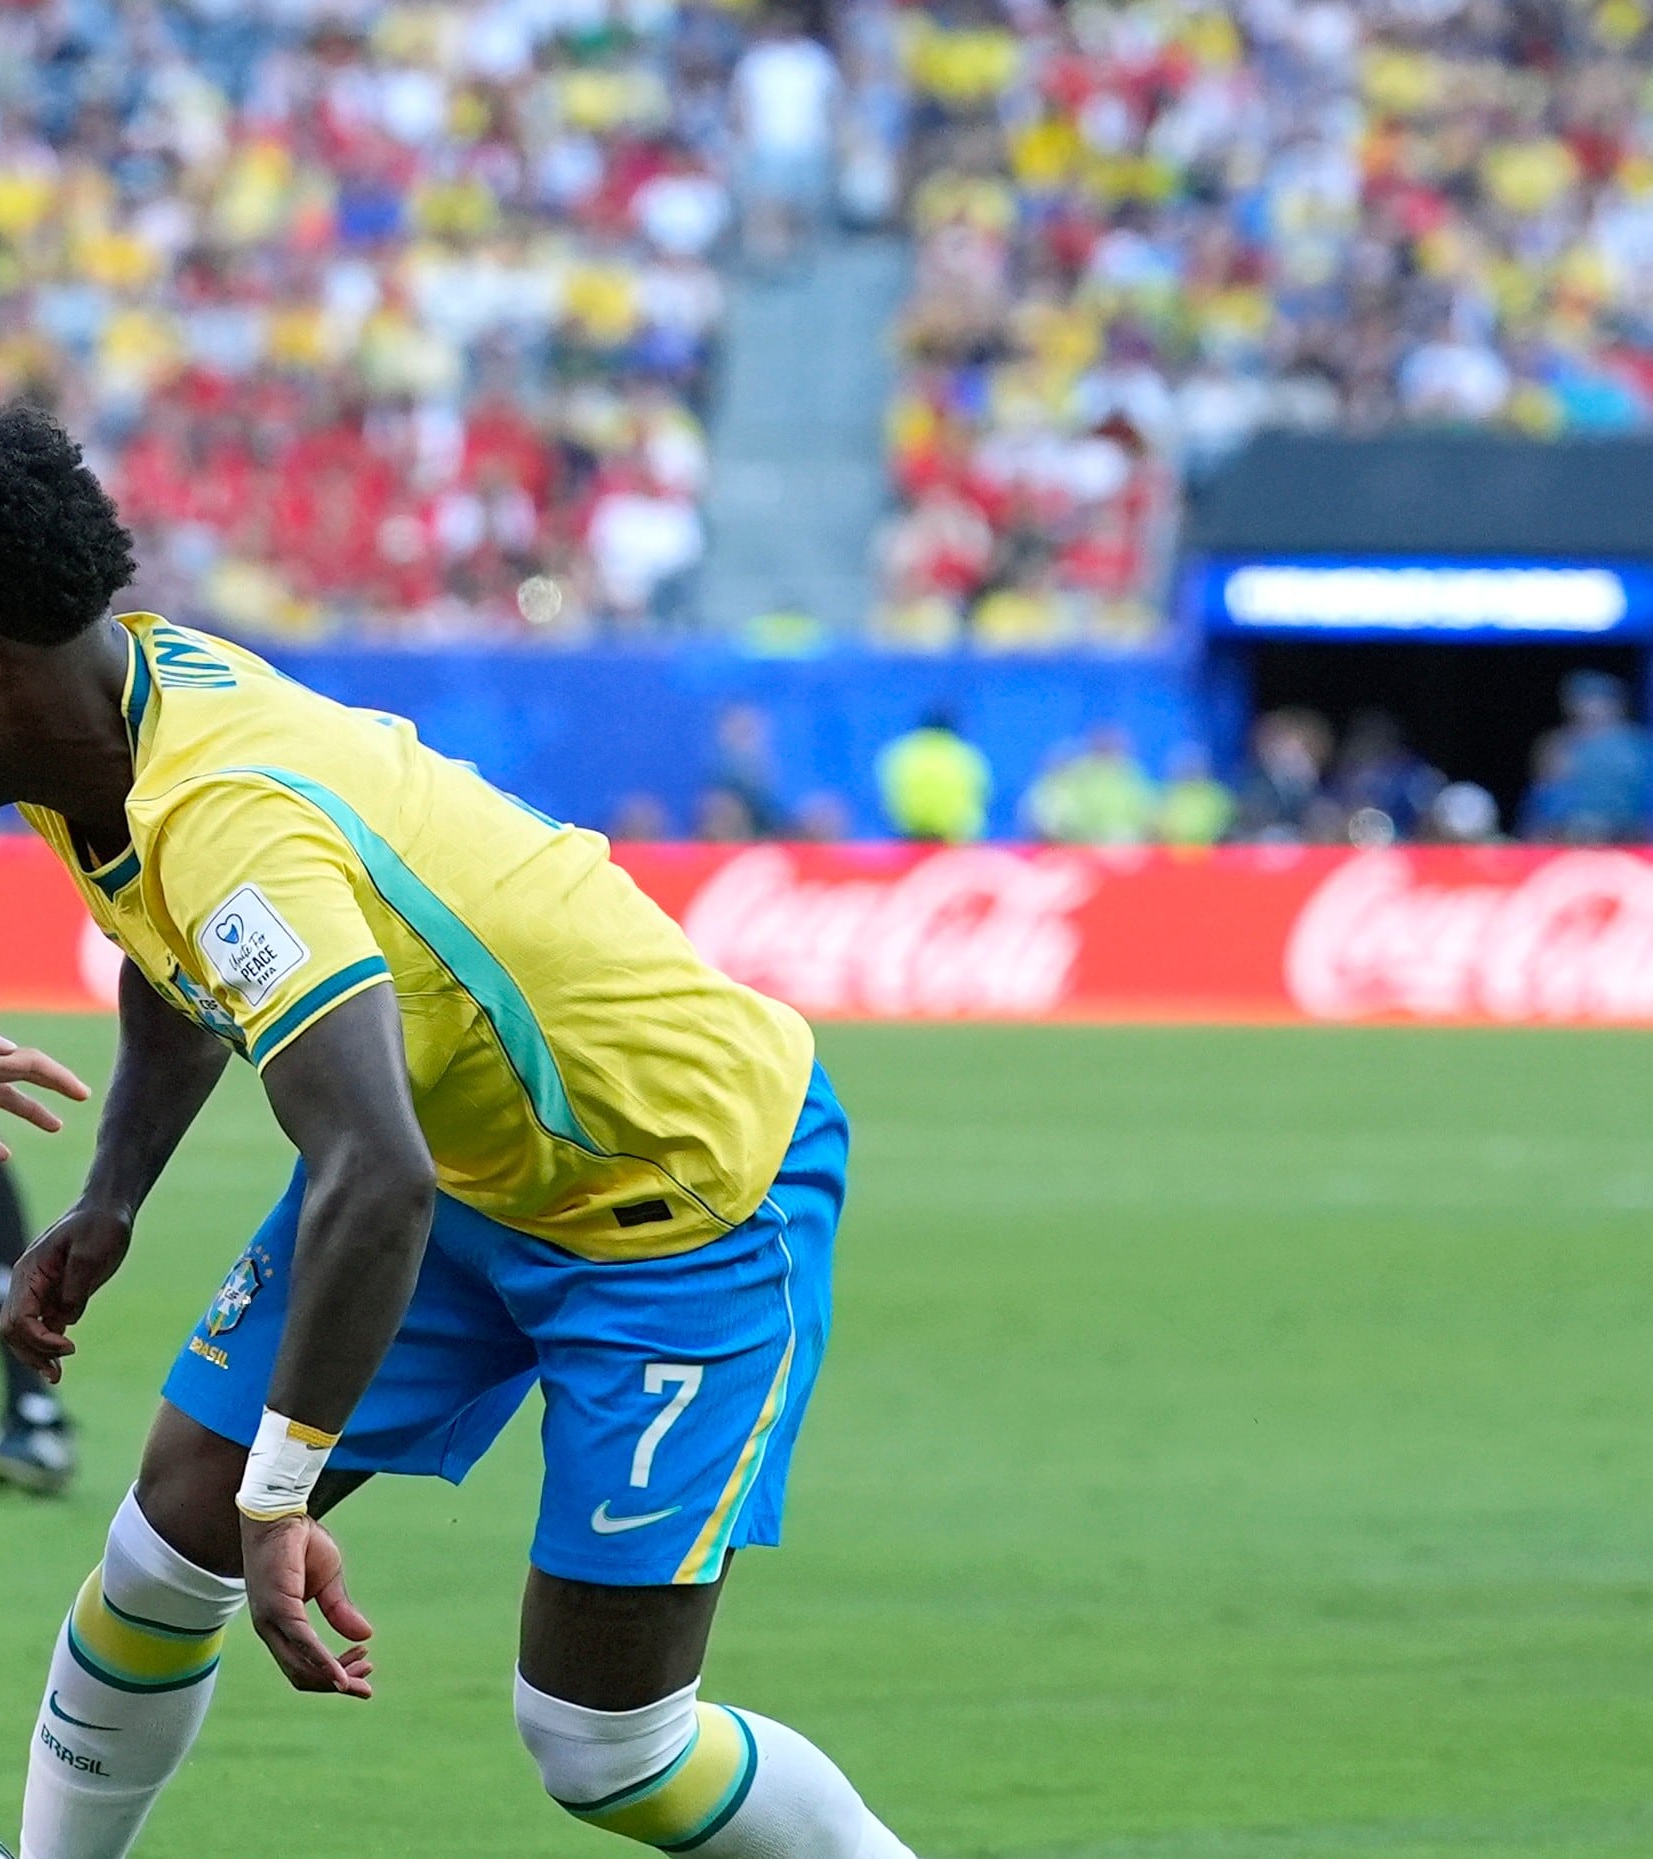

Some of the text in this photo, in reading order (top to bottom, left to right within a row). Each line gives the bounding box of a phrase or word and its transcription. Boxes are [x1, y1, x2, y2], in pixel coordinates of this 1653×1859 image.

[229, 931, 267, 971] Unite For
[240, 944, 278, 983] PEACE
[256, 966, 277, 986] FIFA
[629, 1363, 704, 1489] 7
[40, 1723, 111, 1777] BRASIL
